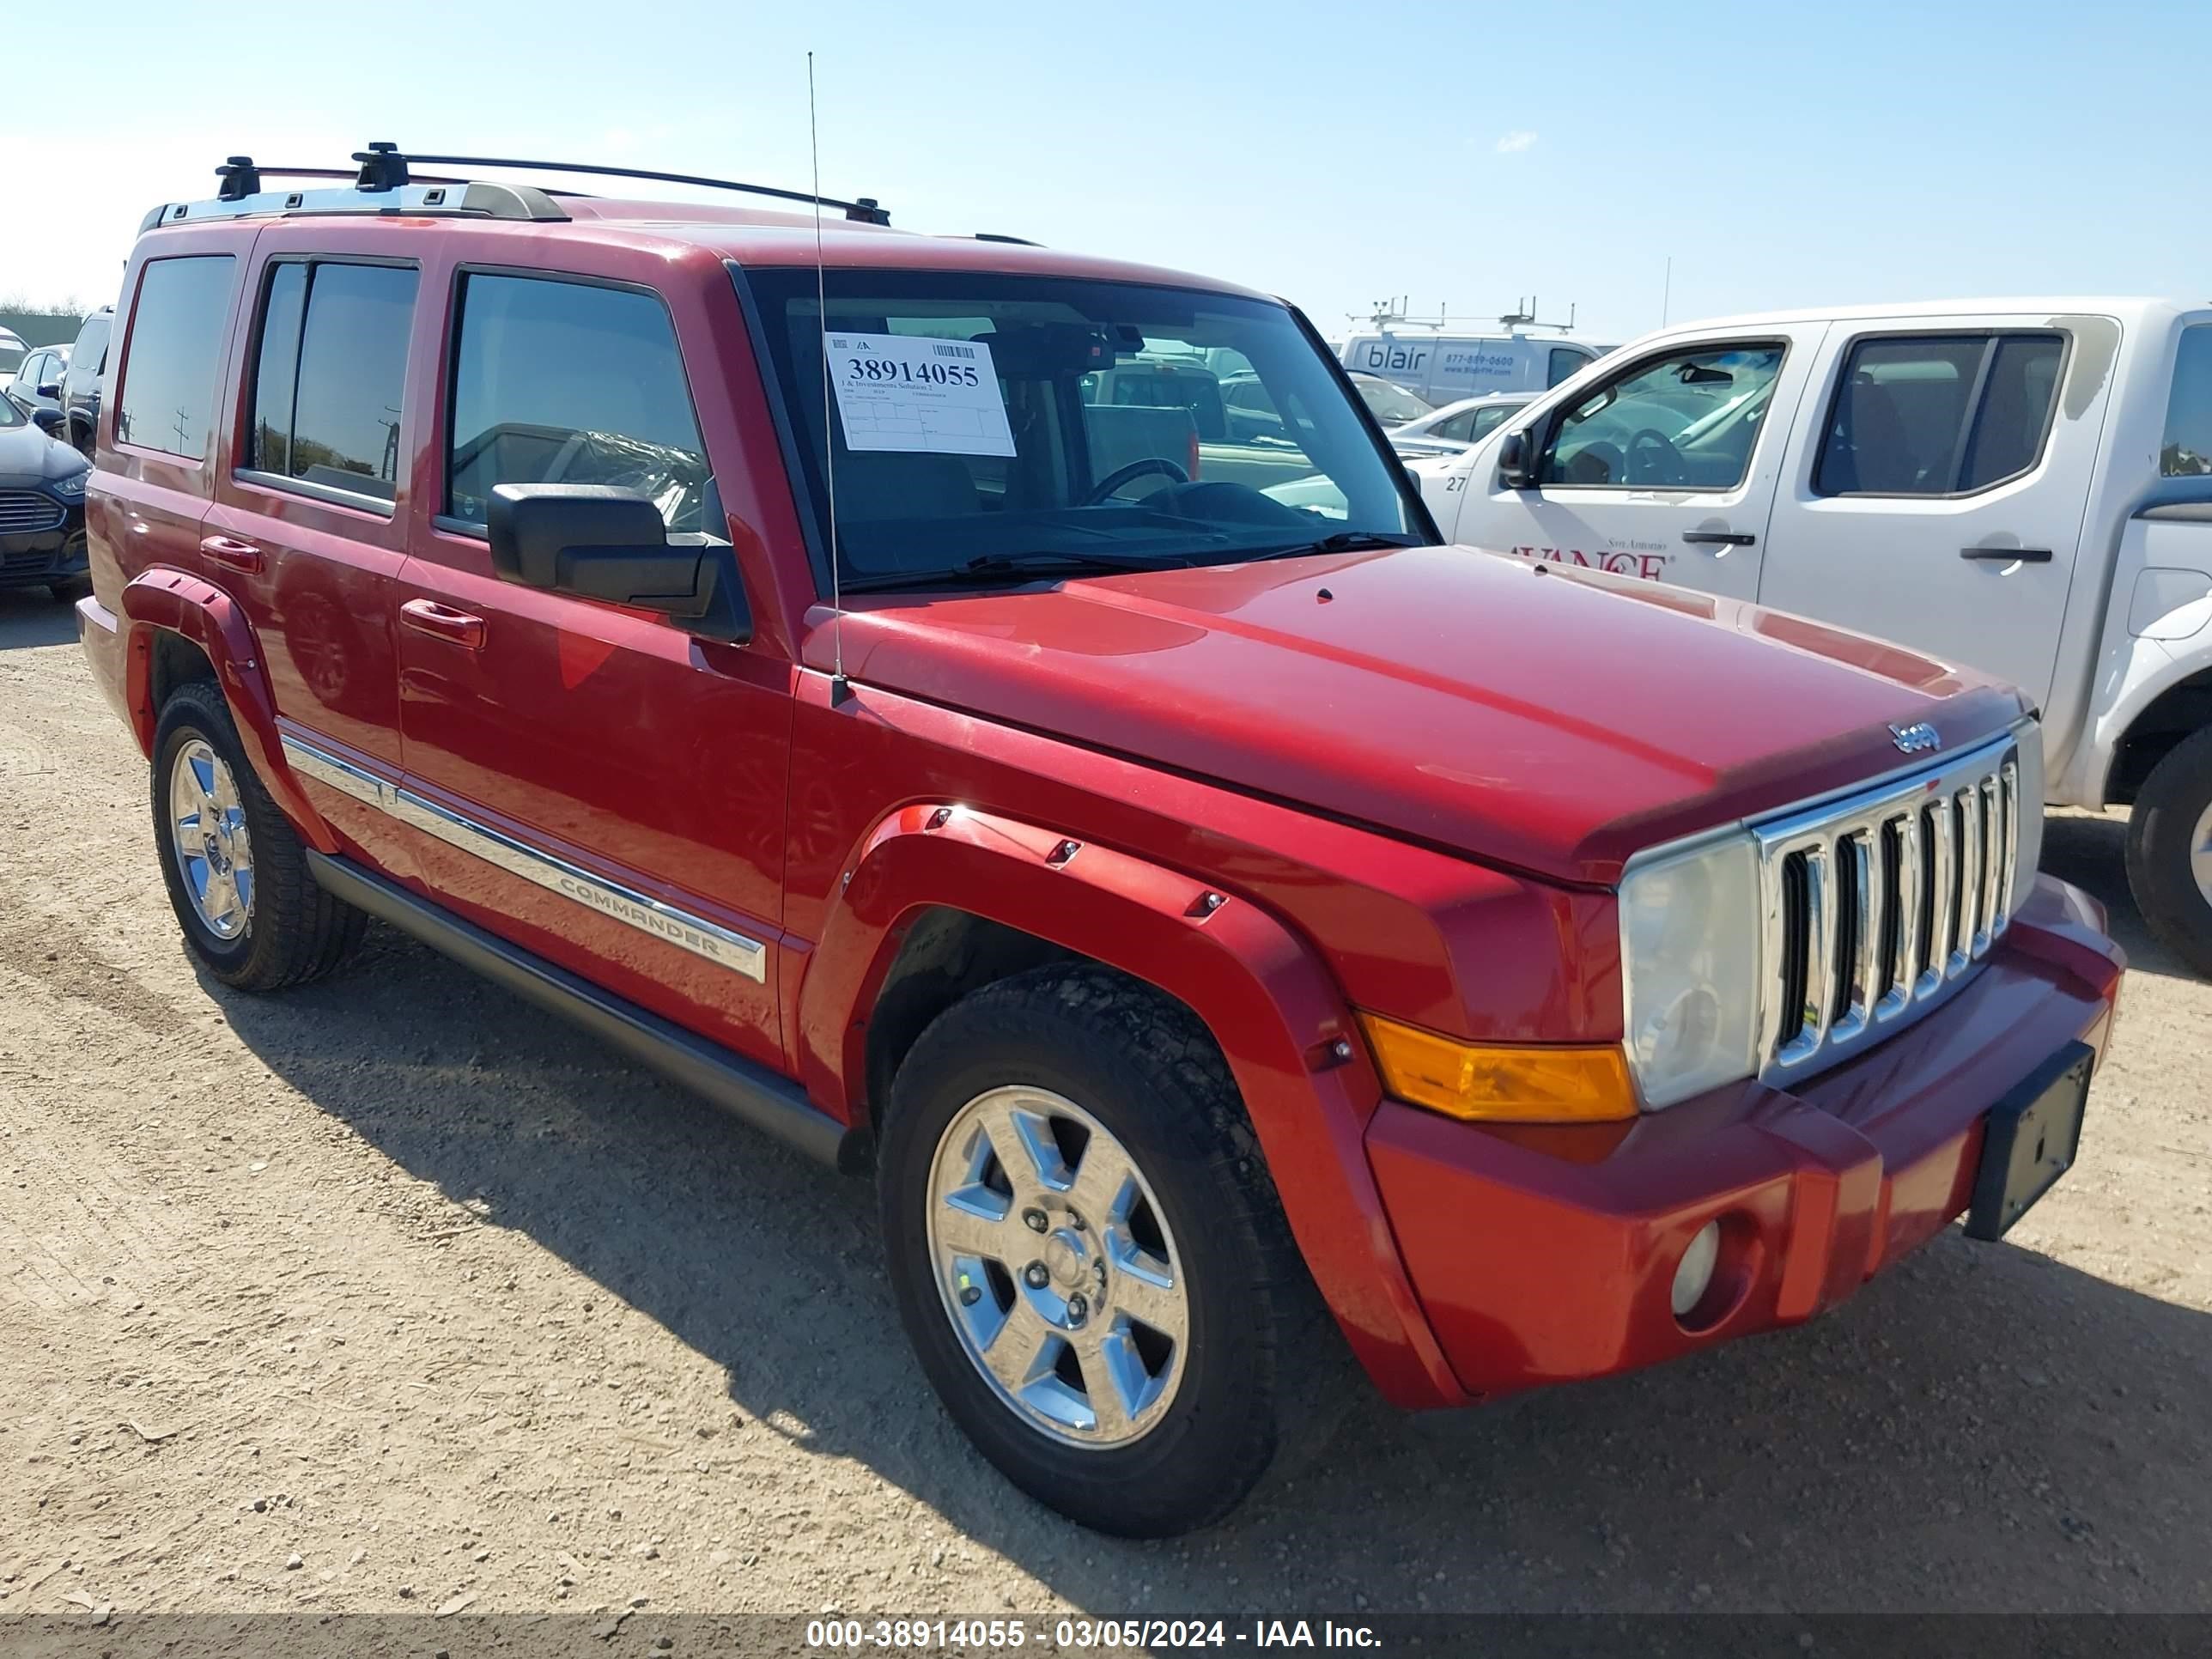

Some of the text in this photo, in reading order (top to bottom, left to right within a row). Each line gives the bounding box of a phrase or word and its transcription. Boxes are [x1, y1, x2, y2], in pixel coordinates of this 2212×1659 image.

[1368, 344, 1426, 370] blair
[848, 358, 979, 387] 38914055
[1446, 477, 1466, 492] 27
[1607, 538, 1667, 550] San Antonio
[1511, 546, 1667, 581] NCE
[560, 878, 720, 955] COMMANDER
